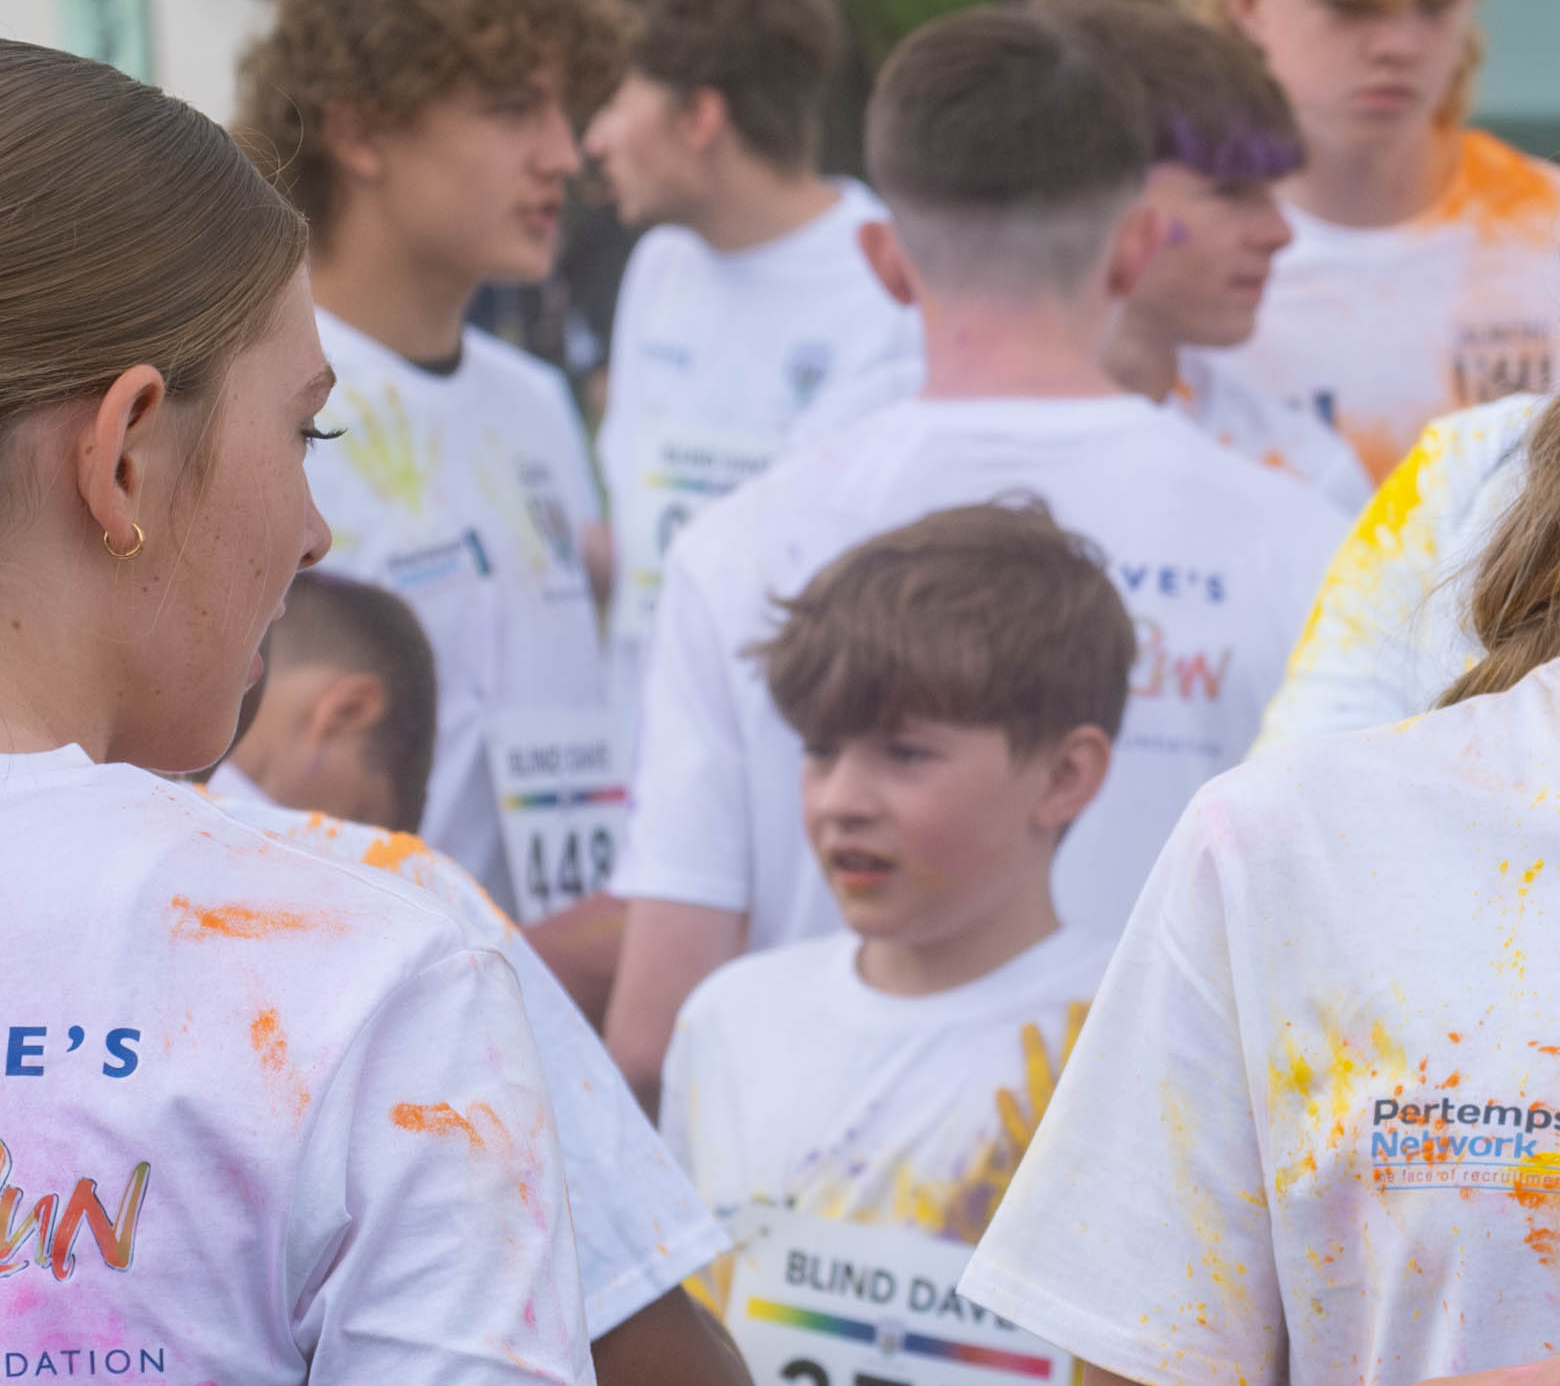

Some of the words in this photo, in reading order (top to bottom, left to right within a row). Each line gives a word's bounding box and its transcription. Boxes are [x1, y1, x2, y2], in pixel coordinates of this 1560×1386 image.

[1121, 566, 1225, 604] VE'S
[1402, 1167, 1433, 1183] face
[1439, 1167, 1456, 1182] of
[786, 1249, 897, 1308] BLIND
